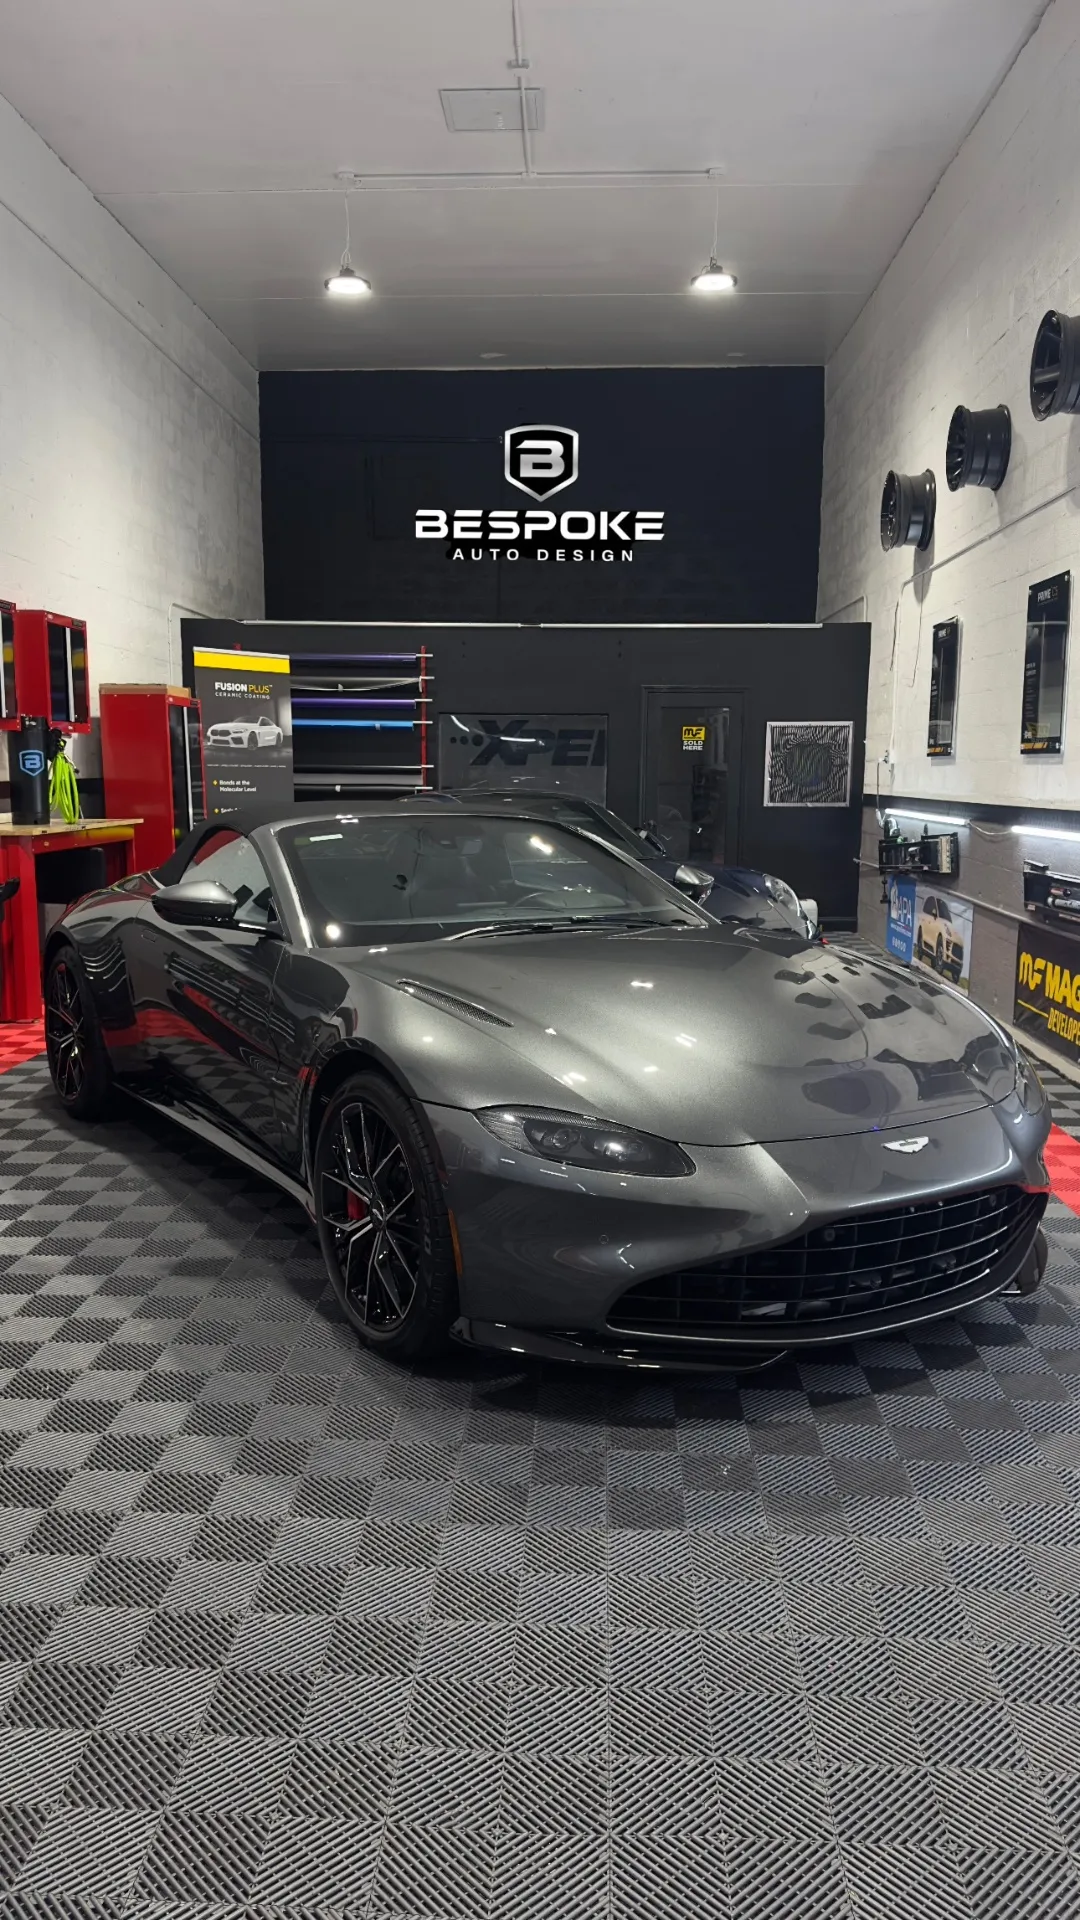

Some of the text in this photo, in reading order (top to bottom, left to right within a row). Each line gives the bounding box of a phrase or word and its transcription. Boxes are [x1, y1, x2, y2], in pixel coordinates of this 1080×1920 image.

[516, 440, 565, 478] B
[415, 509, 665, 541] BESPOKE
[452, 548, 633, 562] AUTO DESIGN
[214, 681, 248, 692] FUSION
[214, 691, 242, 699] CERAMIC
